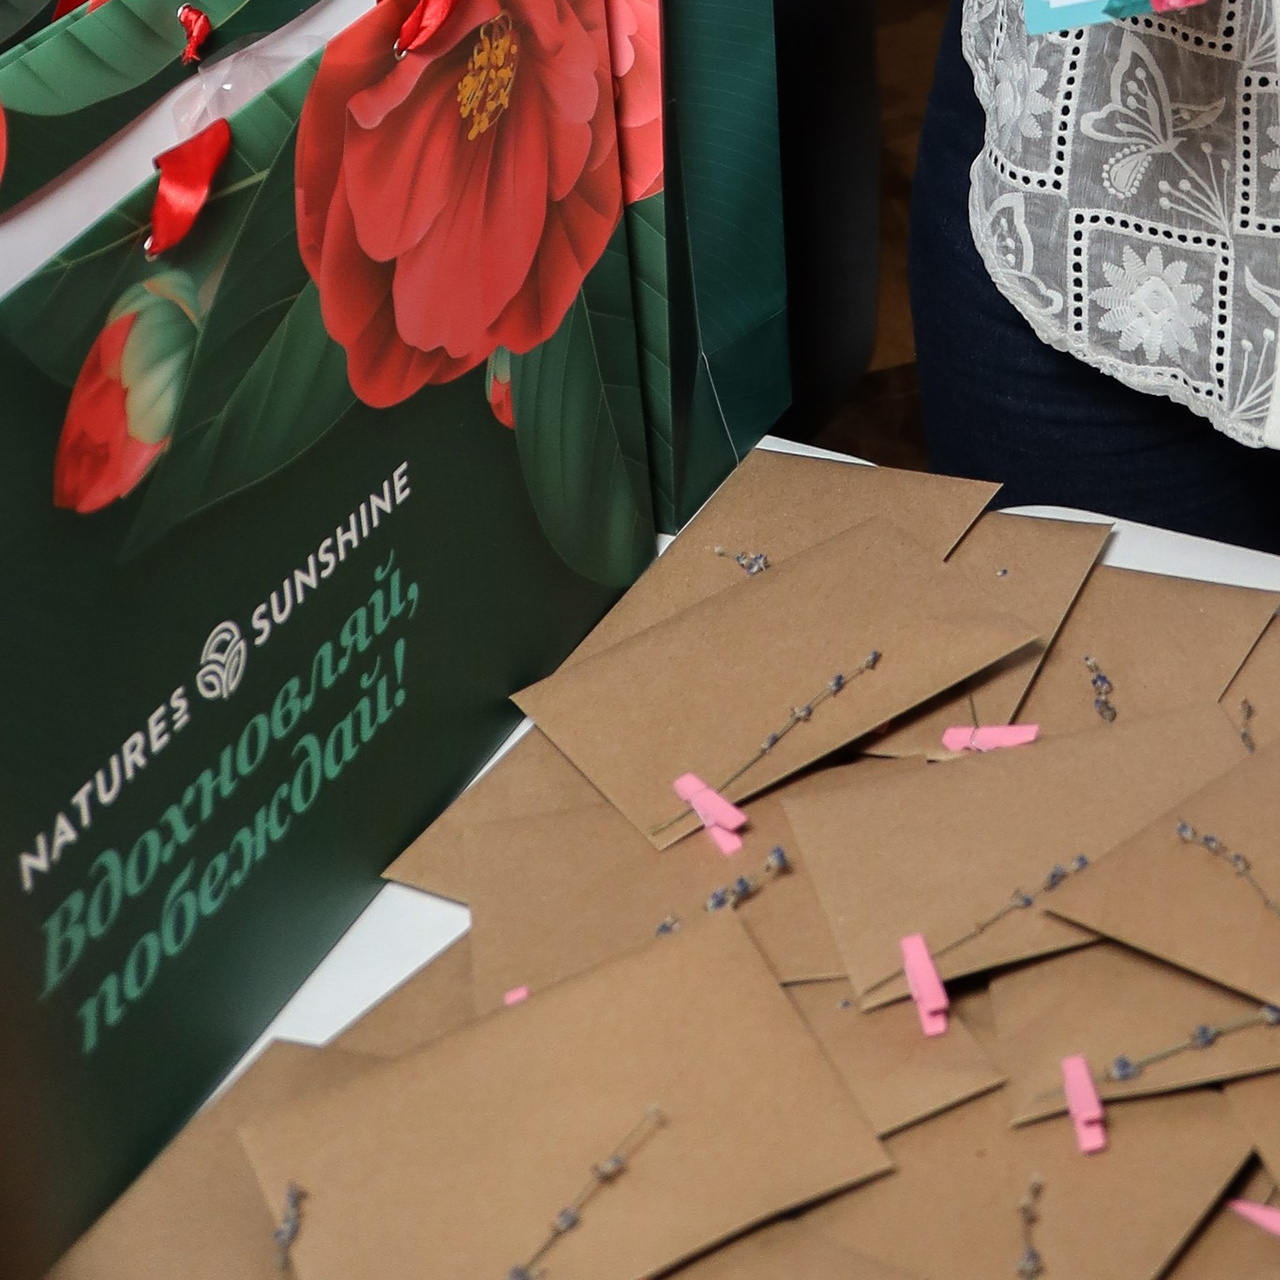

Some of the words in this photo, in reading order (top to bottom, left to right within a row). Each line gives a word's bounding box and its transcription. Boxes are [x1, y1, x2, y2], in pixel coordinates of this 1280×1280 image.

[19, 686, 190, 892] NATURES
[251, 461, 412, 647] SUNSHINE
[40, 549, 420, 1000] Вдохновляй,
[78, 638, 407, 1055] побеждай!
